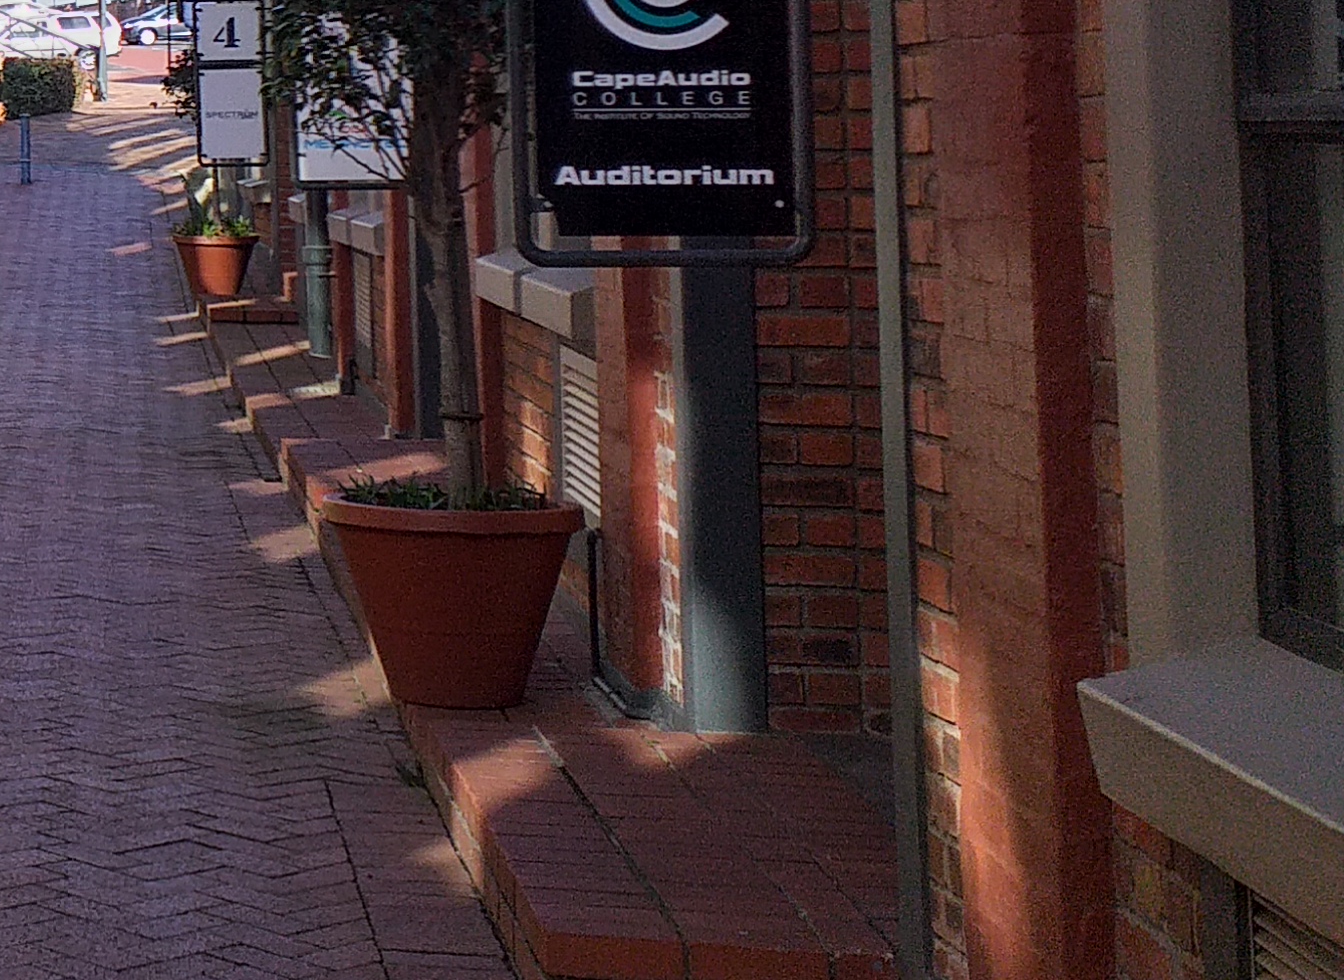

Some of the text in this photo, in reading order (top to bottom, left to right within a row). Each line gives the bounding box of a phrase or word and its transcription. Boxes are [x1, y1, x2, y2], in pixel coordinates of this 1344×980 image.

[213, 17, 241, 48] 4
[573, 70, 752, 90] CapeAudio
[573, 91, 752, 106] COLLEGE
[555, 165, 775, 186] Auditorium
